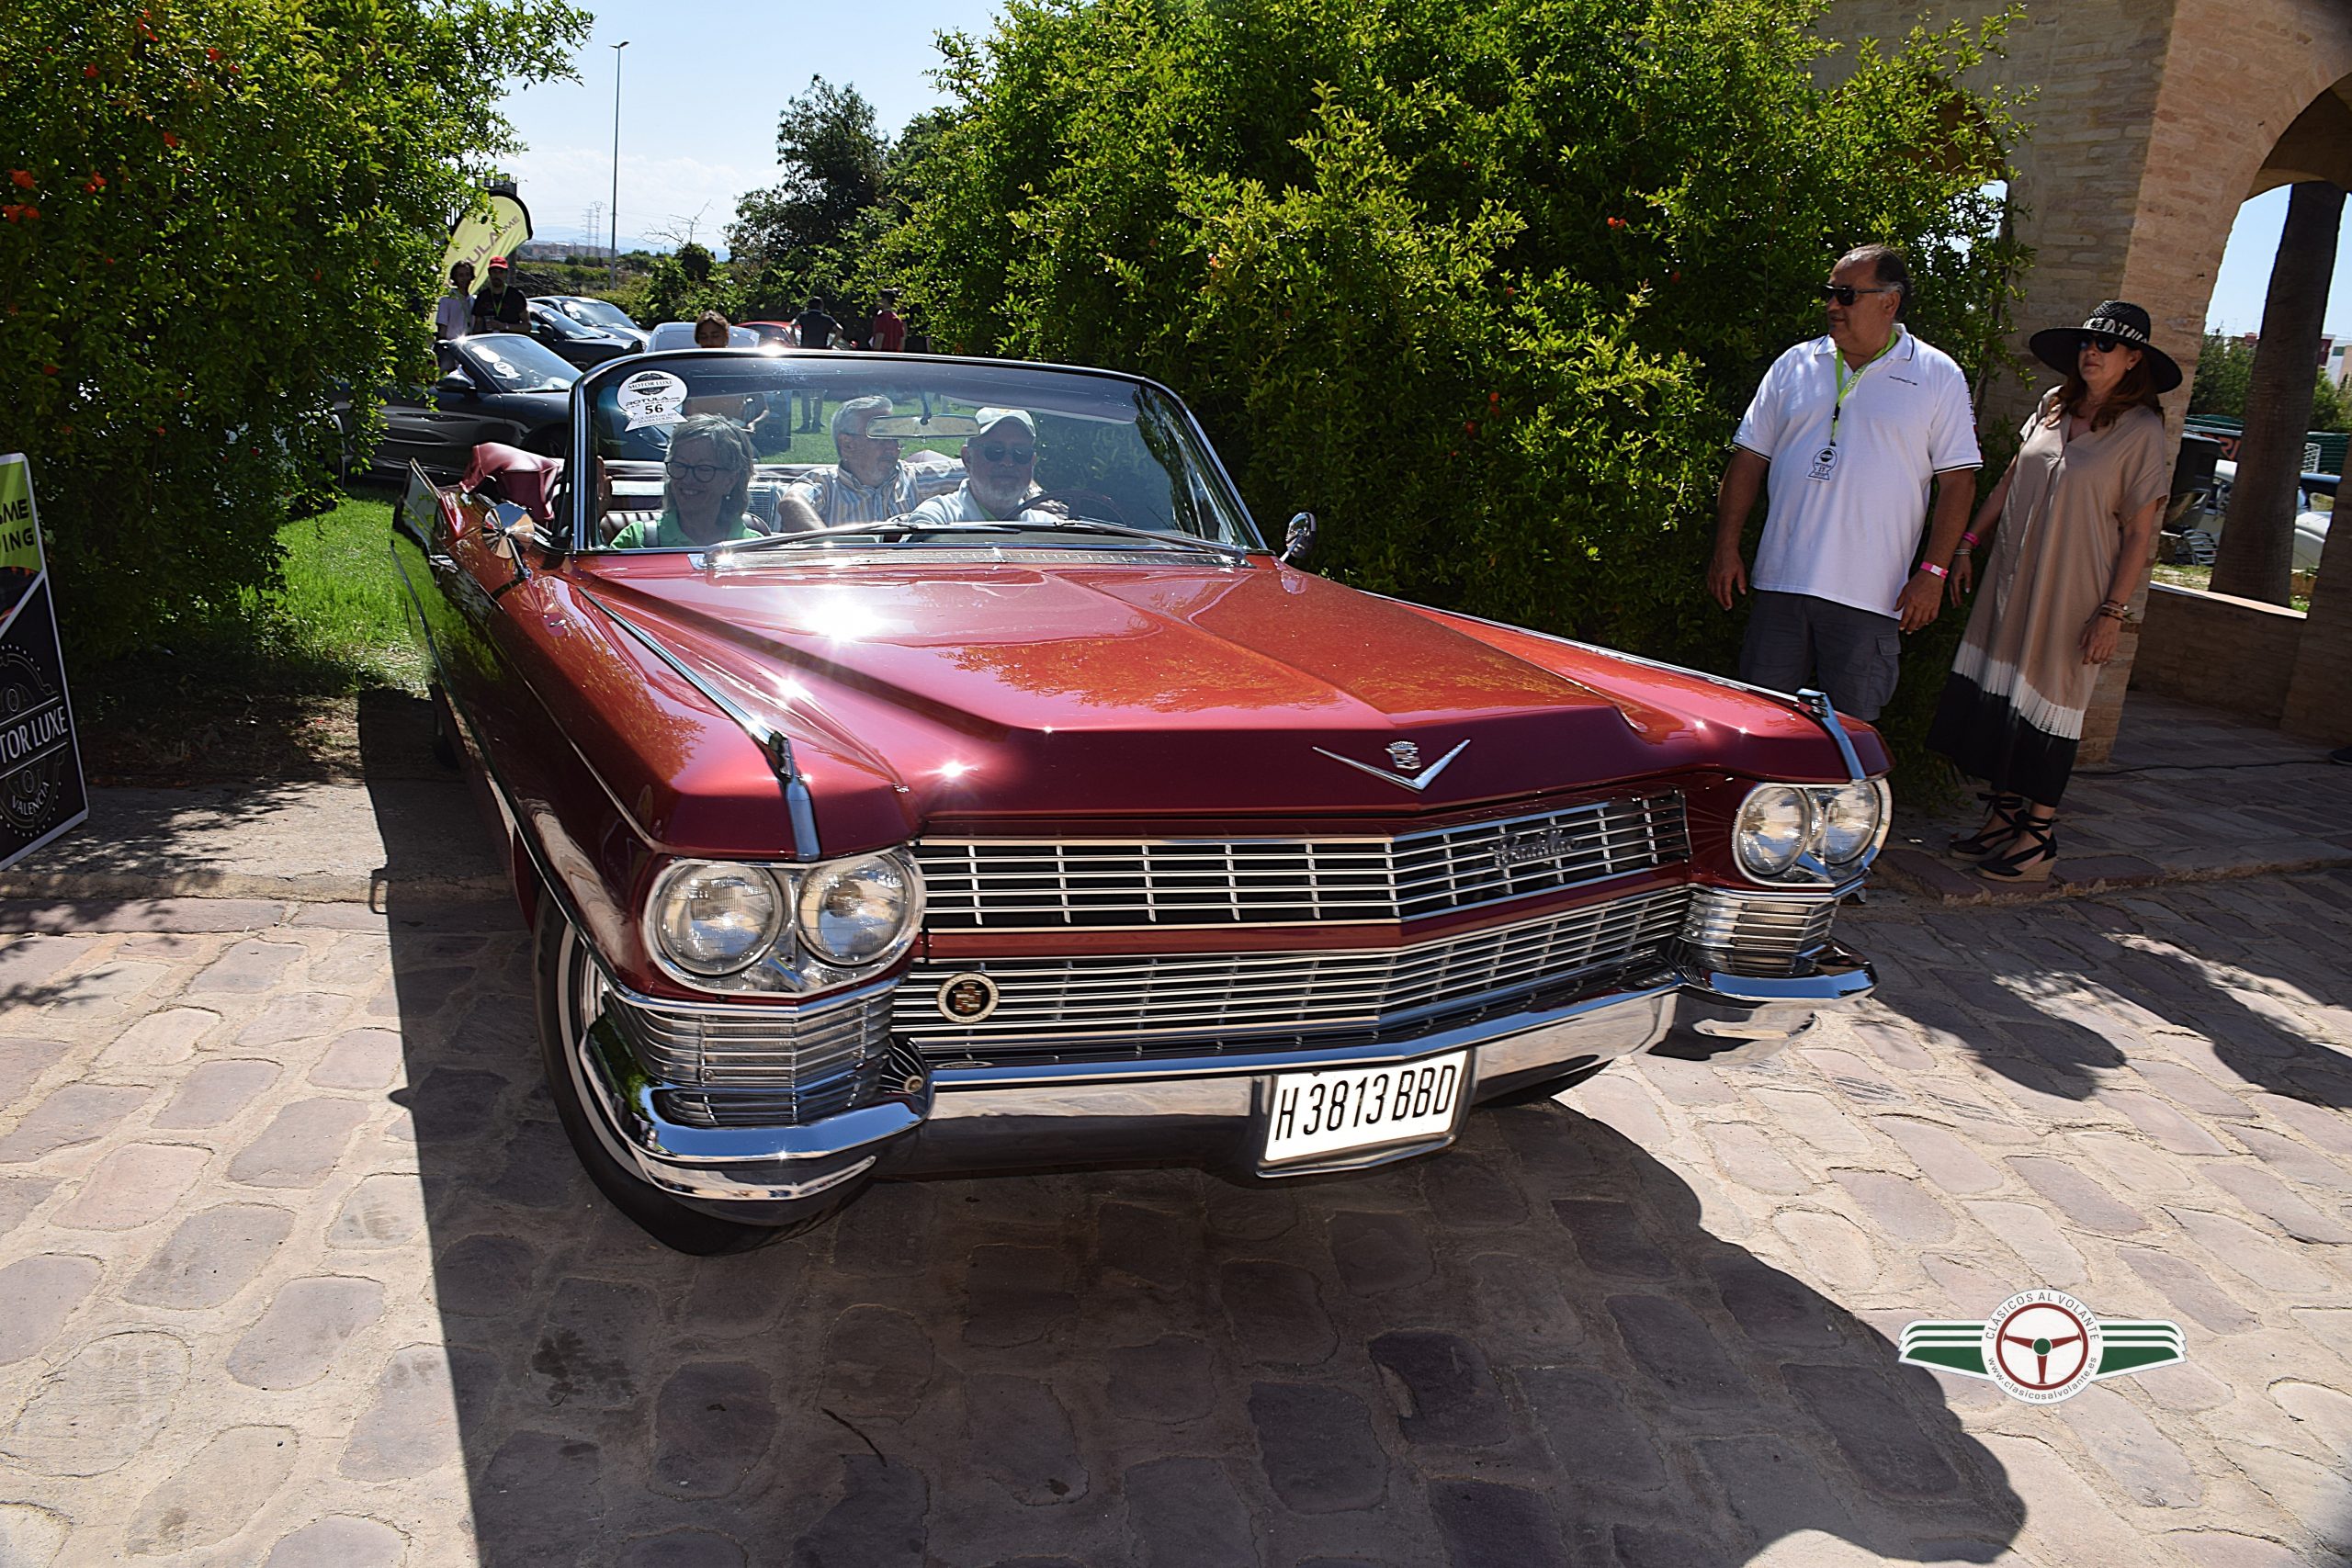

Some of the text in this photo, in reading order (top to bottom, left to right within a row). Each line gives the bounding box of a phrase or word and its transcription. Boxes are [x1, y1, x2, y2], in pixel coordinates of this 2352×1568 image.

[628, 381, 655, 389] MOTOR
[645, 404, 663, 414] 56
[31, 705, 69, 747] LUXE
[12, 781, 51, 816] VALENCIA
[1275, 1065, 1457, 1141] H 3813 BBD
